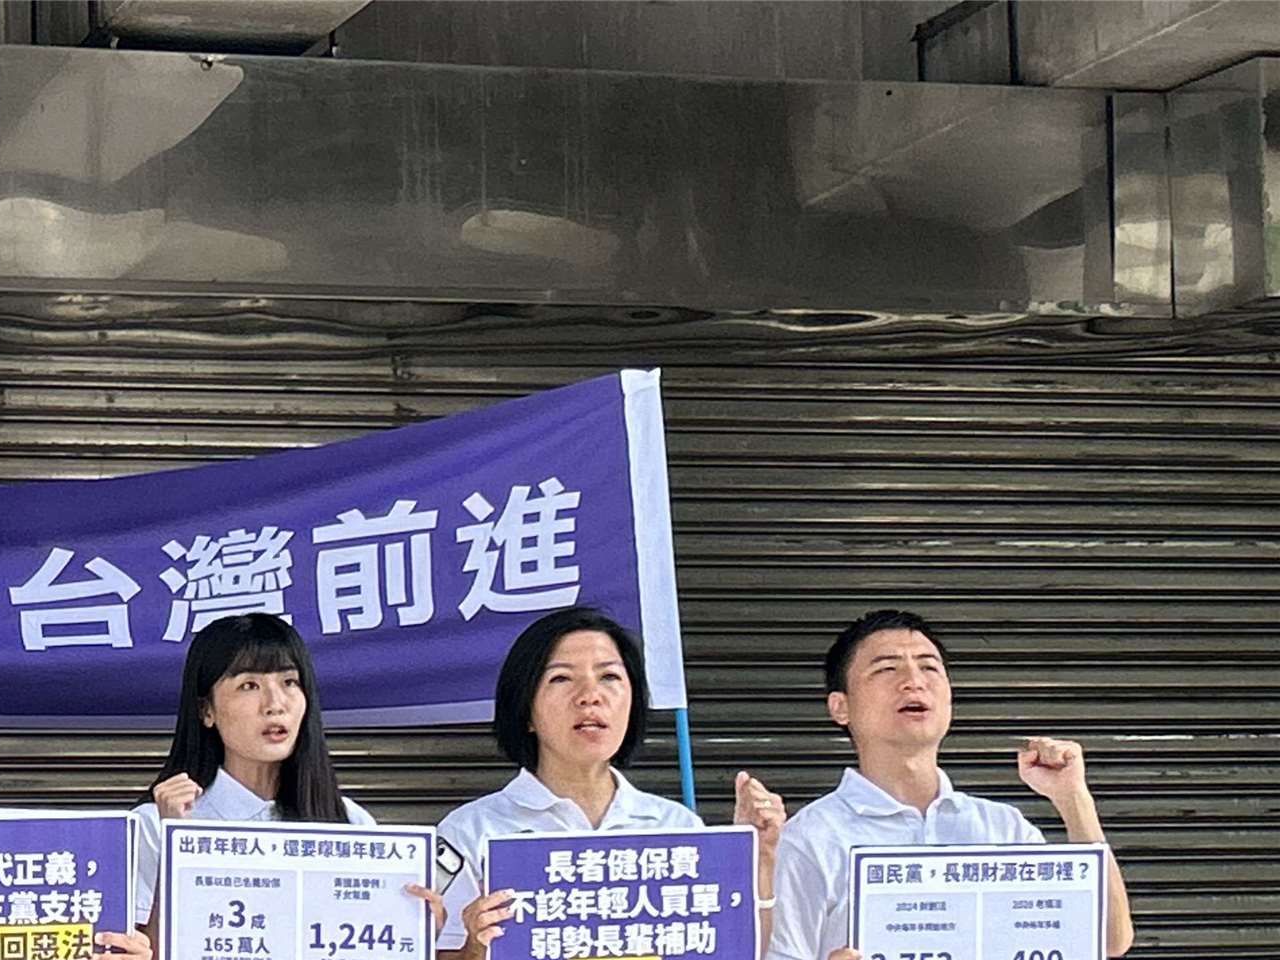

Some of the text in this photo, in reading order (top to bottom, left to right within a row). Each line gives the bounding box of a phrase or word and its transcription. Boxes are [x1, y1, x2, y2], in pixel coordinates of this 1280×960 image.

[10, 476, 583, 651] 台灣前進
[544, 846, 700, 883] 長者健保費
[209, 900, 266, 929] 約 3 成
[507, 883, 742, 923] 不該年輕人買單，
[204, 937, 270, 954] 165 萬人
[309, 922, 414, 957] 1,244 元
[530, 921, 717, 960] 弱勢長輩補助
